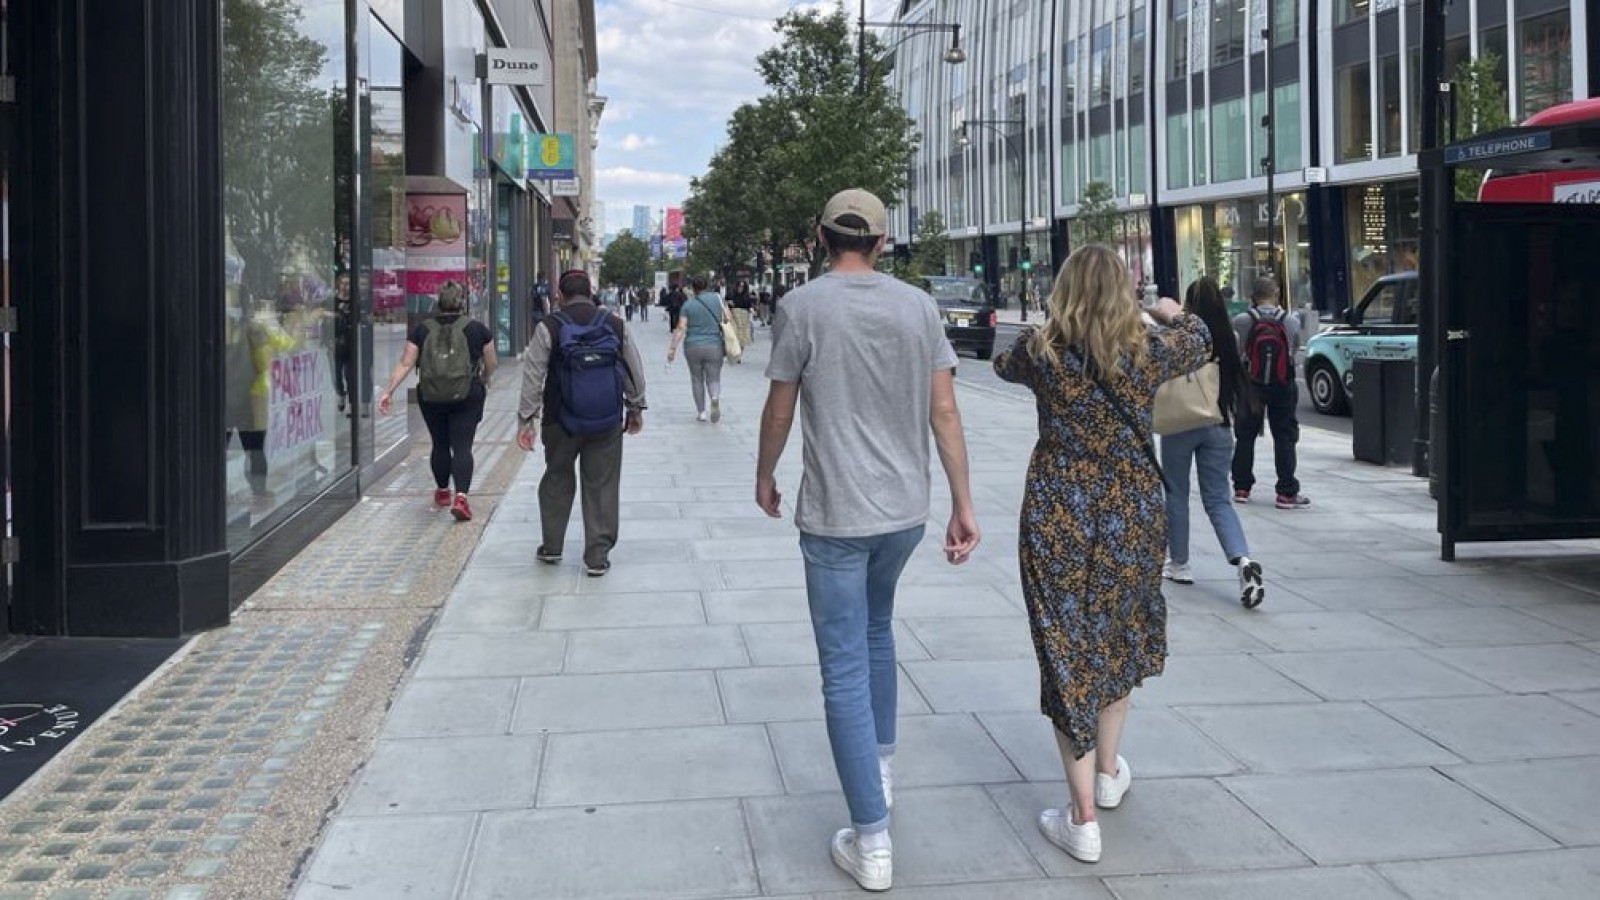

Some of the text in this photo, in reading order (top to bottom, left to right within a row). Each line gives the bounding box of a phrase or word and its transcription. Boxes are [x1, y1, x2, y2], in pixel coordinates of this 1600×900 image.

[492, 58, 539, 71] Dune
[1468, 136, 1536, 156] TELEPHONE
[271, 350, 318, 405] PARTY
[287, 393, 323, 449] PARK
